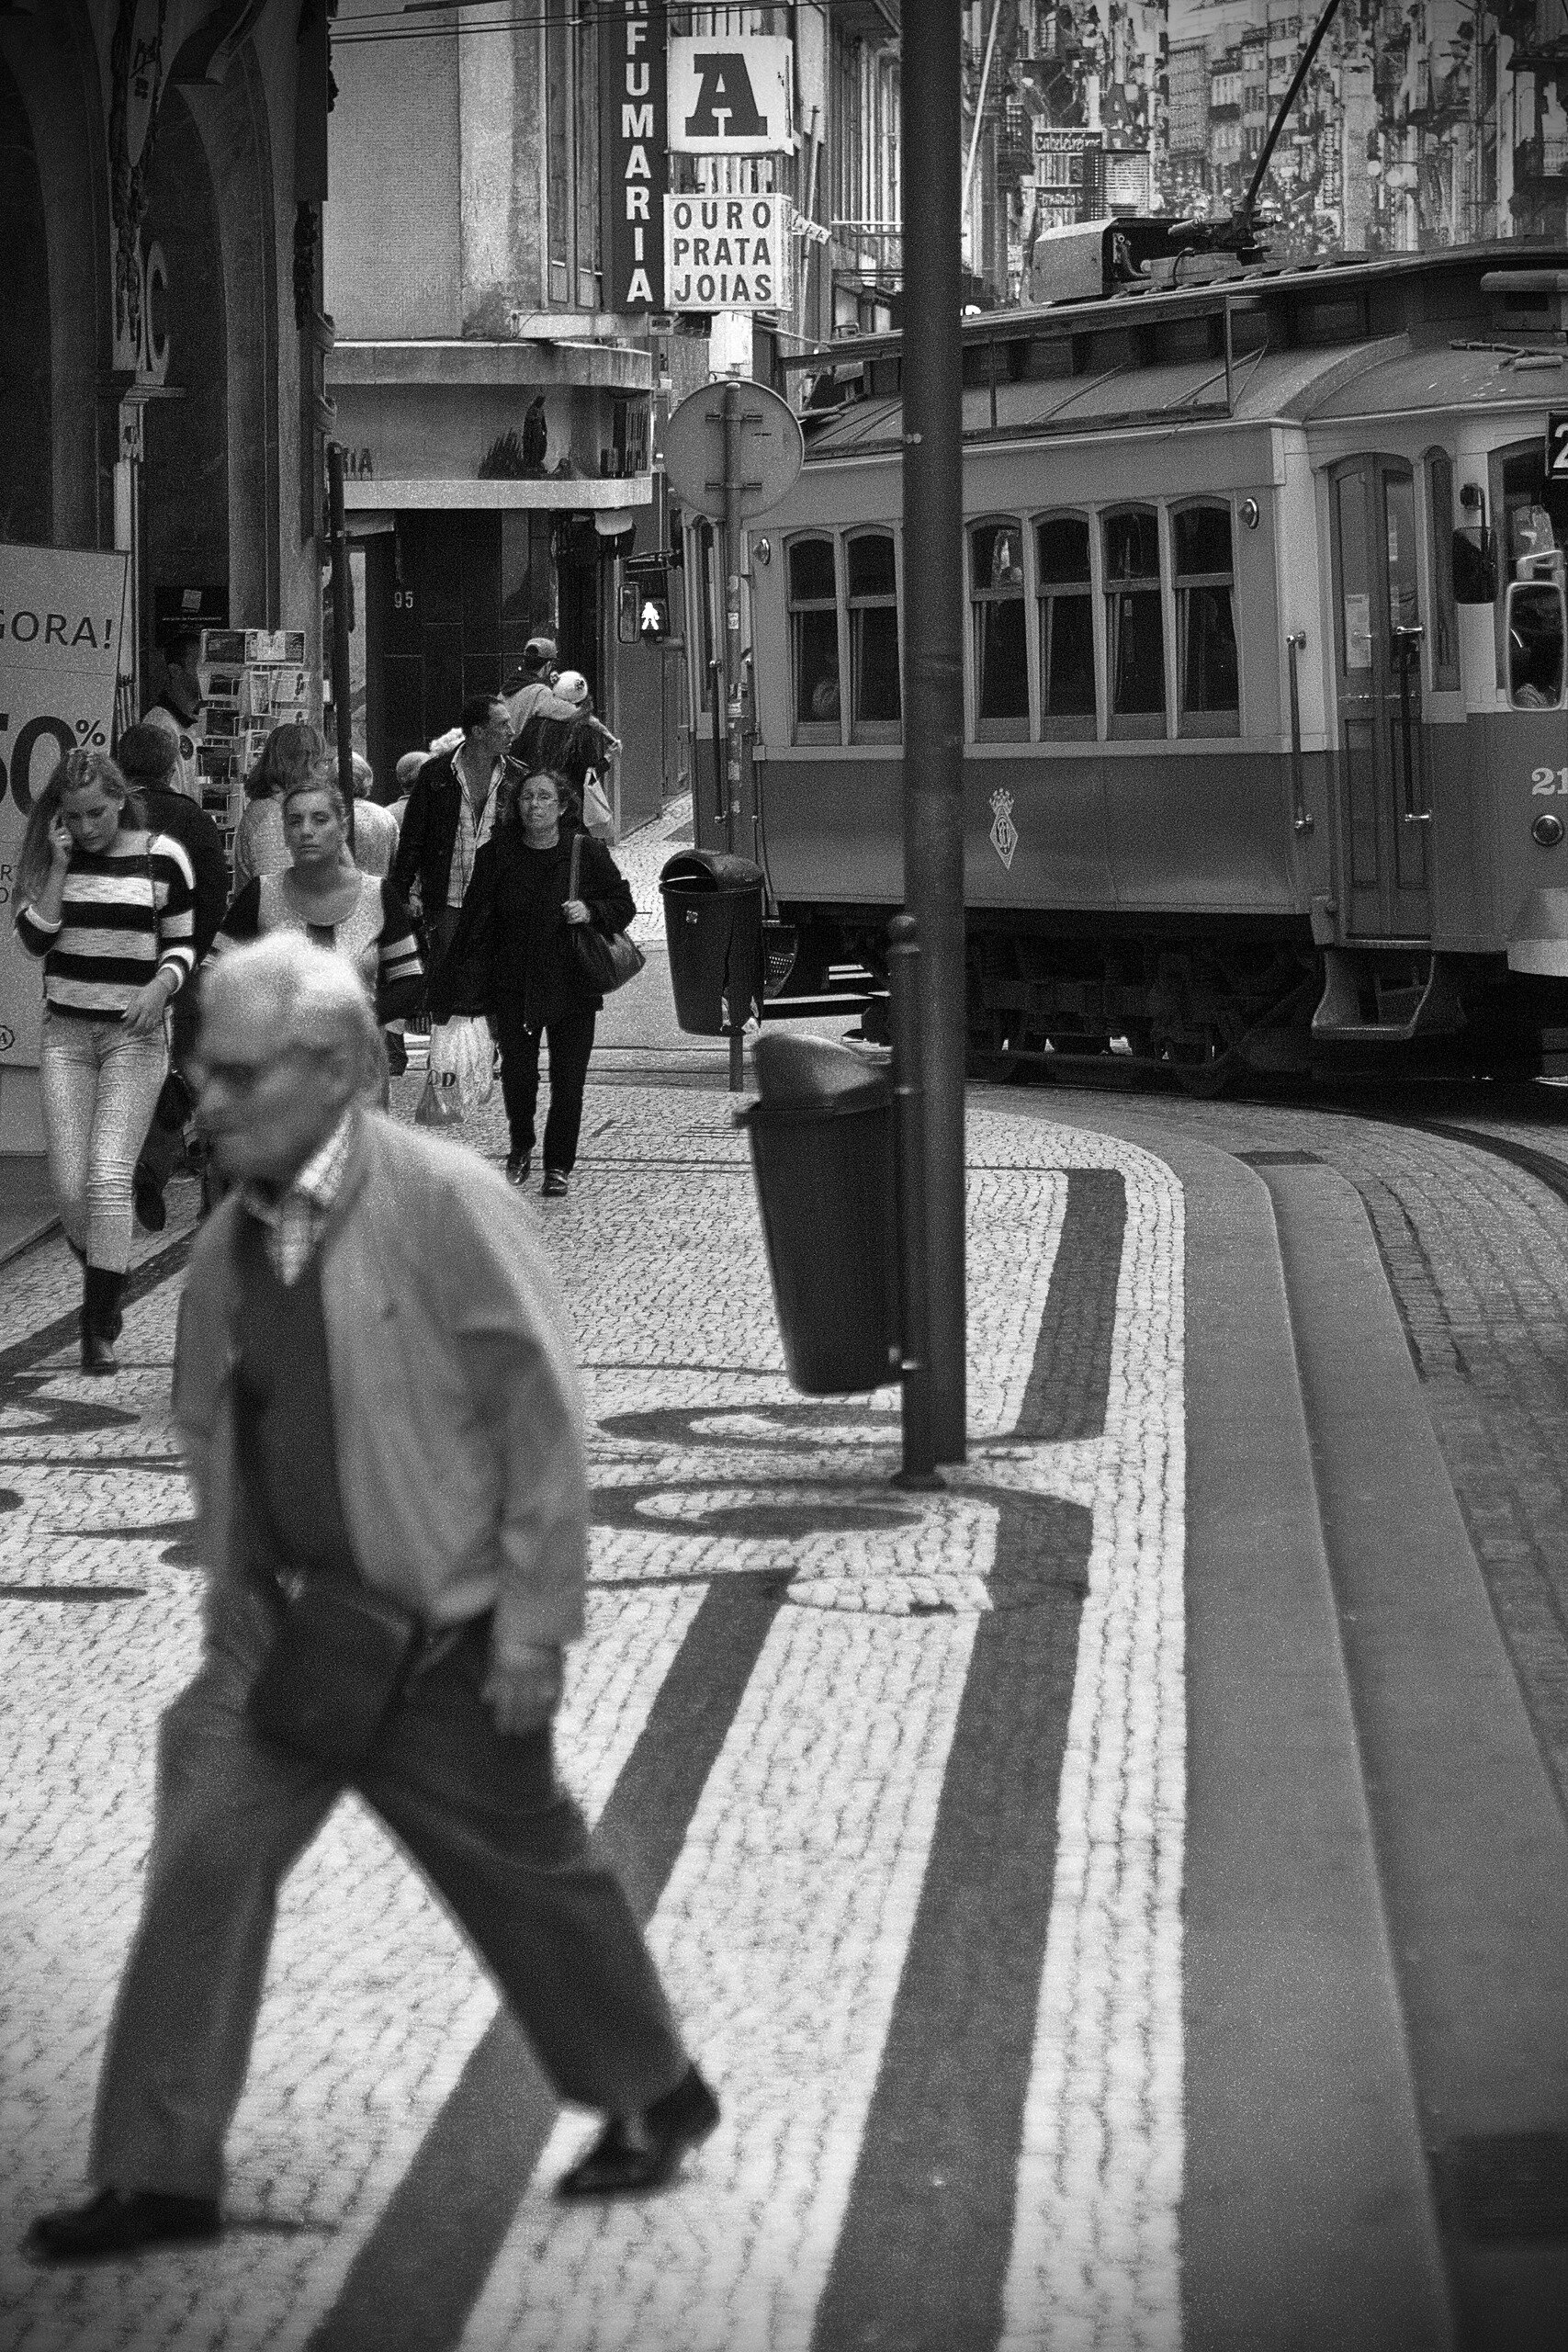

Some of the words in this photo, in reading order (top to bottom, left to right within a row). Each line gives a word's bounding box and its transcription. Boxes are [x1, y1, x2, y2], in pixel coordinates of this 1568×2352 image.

[672, 201, 772, 230] OURO
[672, 237, 772, 266] PRATA
[673, 274, 773, 302] JOIAS
[0, 610, 112, 650] ORA!
[0, 712, 106, 818] 0%
